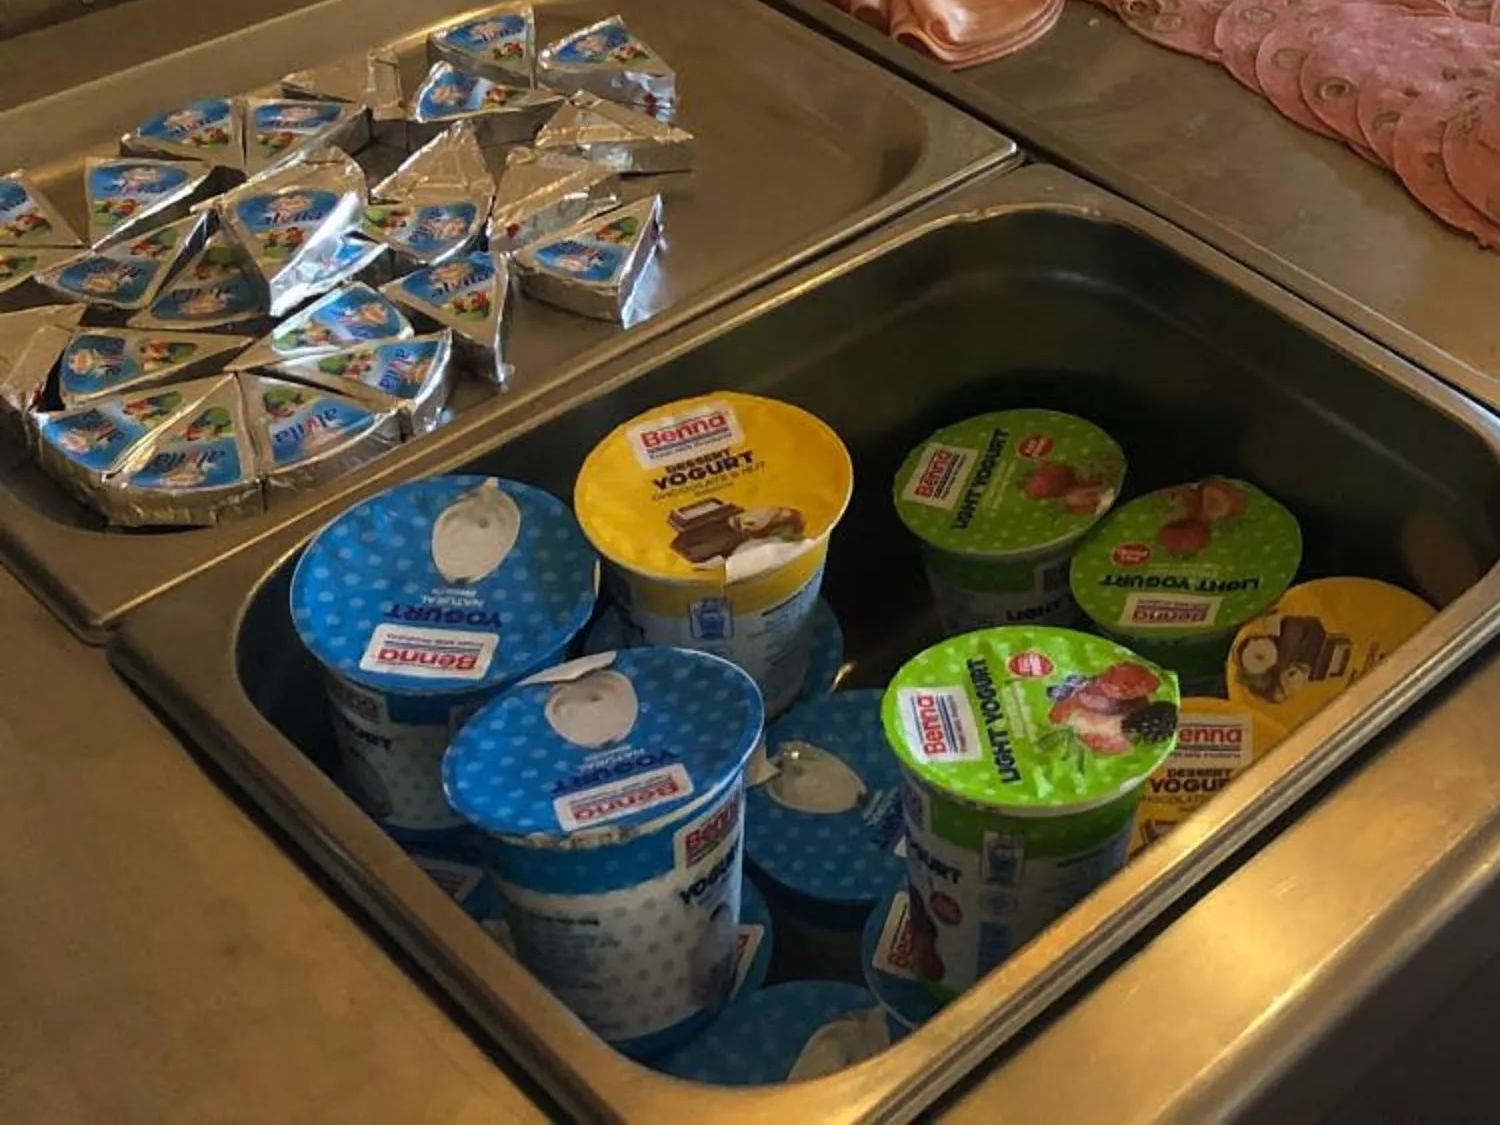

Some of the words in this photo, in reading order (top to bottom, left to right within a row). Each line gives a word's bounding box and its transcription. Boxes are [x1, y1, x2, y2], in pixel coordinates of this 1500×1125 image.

[640, 414, 728, 448] Benna
[652, 449, 754, 491] YOGURT
[665, 447, 732, 473] DESSERT
[913, 449, 950, 499] Benna
[951, 488, 981, 530] LIGHT
[971, 427, 1009, 488] YOGURT
[1100, 574, 1190, 591] YOGURT
[1193, 577, 1260, 593] LIGHT
[383, 603, 502, 628] YOGURT
[1132, 608, 1210, 624] Benna
[377, 647, 479, 671] Benna
[966, 658, 1004, 725] YOGURT
[916, 694, 947, 755] Benna
[1180, 728, 1242, 743] enna
[552, 748, 680, 795] YOGURT
[987, 727, 1022, 783] LIGHT
[575, 782, 679, 820] Benna
